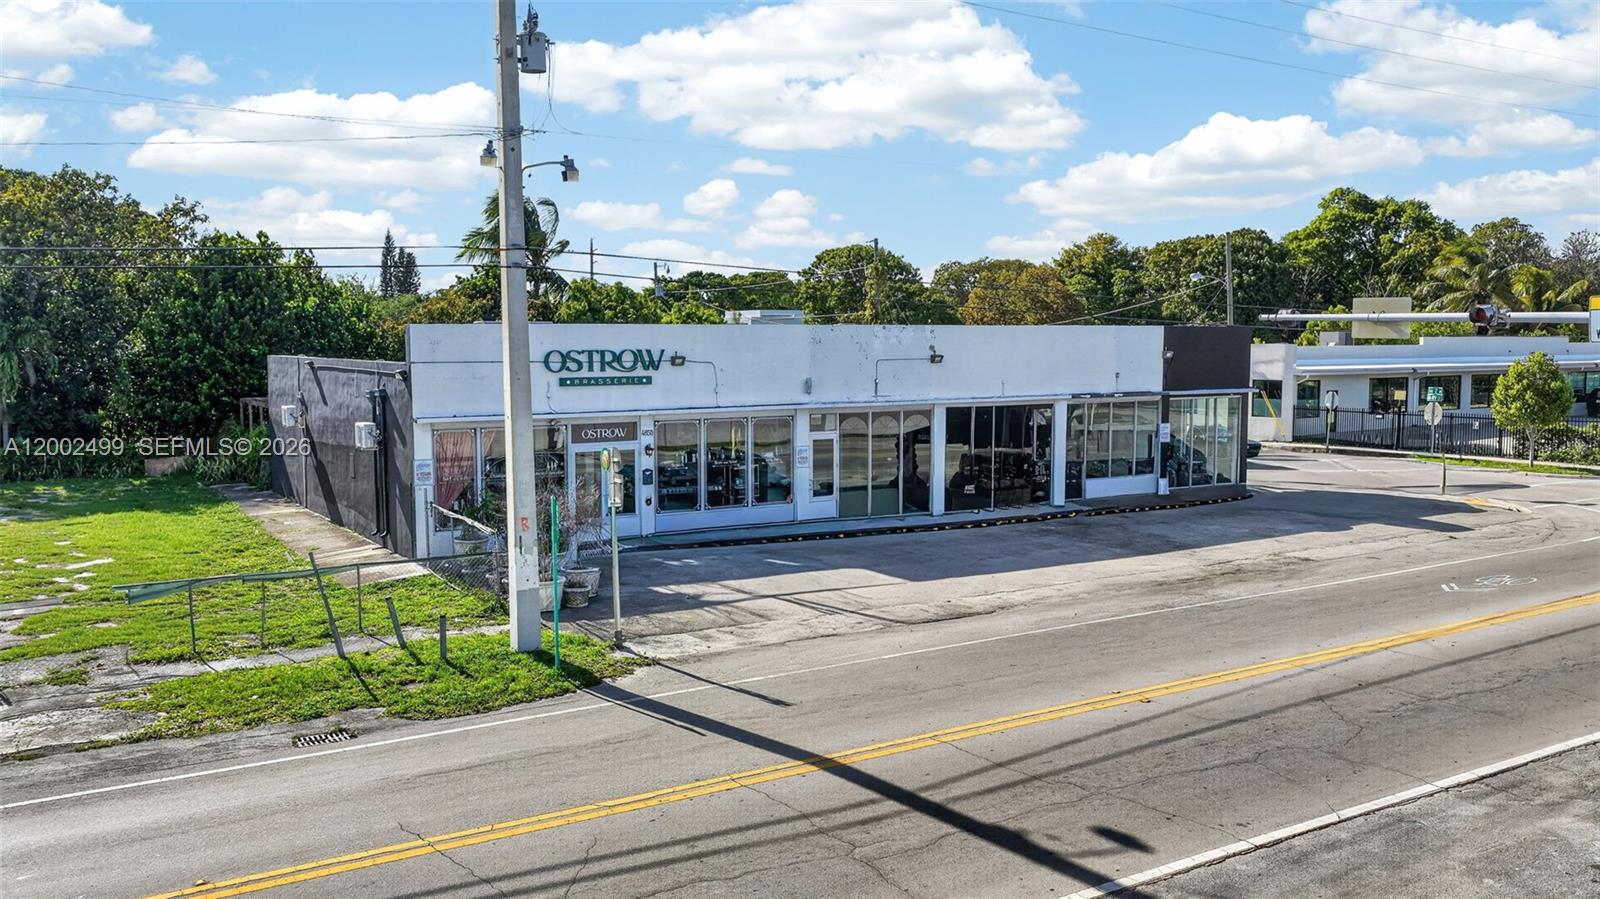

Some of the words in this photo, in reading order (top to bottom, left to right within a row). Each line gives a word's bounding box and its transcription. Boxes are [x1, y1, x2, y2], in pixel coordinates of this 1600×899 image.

[543, 349, 666, 373] OSTROW
[574, 377, 640, 385] BRASSERIE
[581, 427, 627, 440] OSTROW
